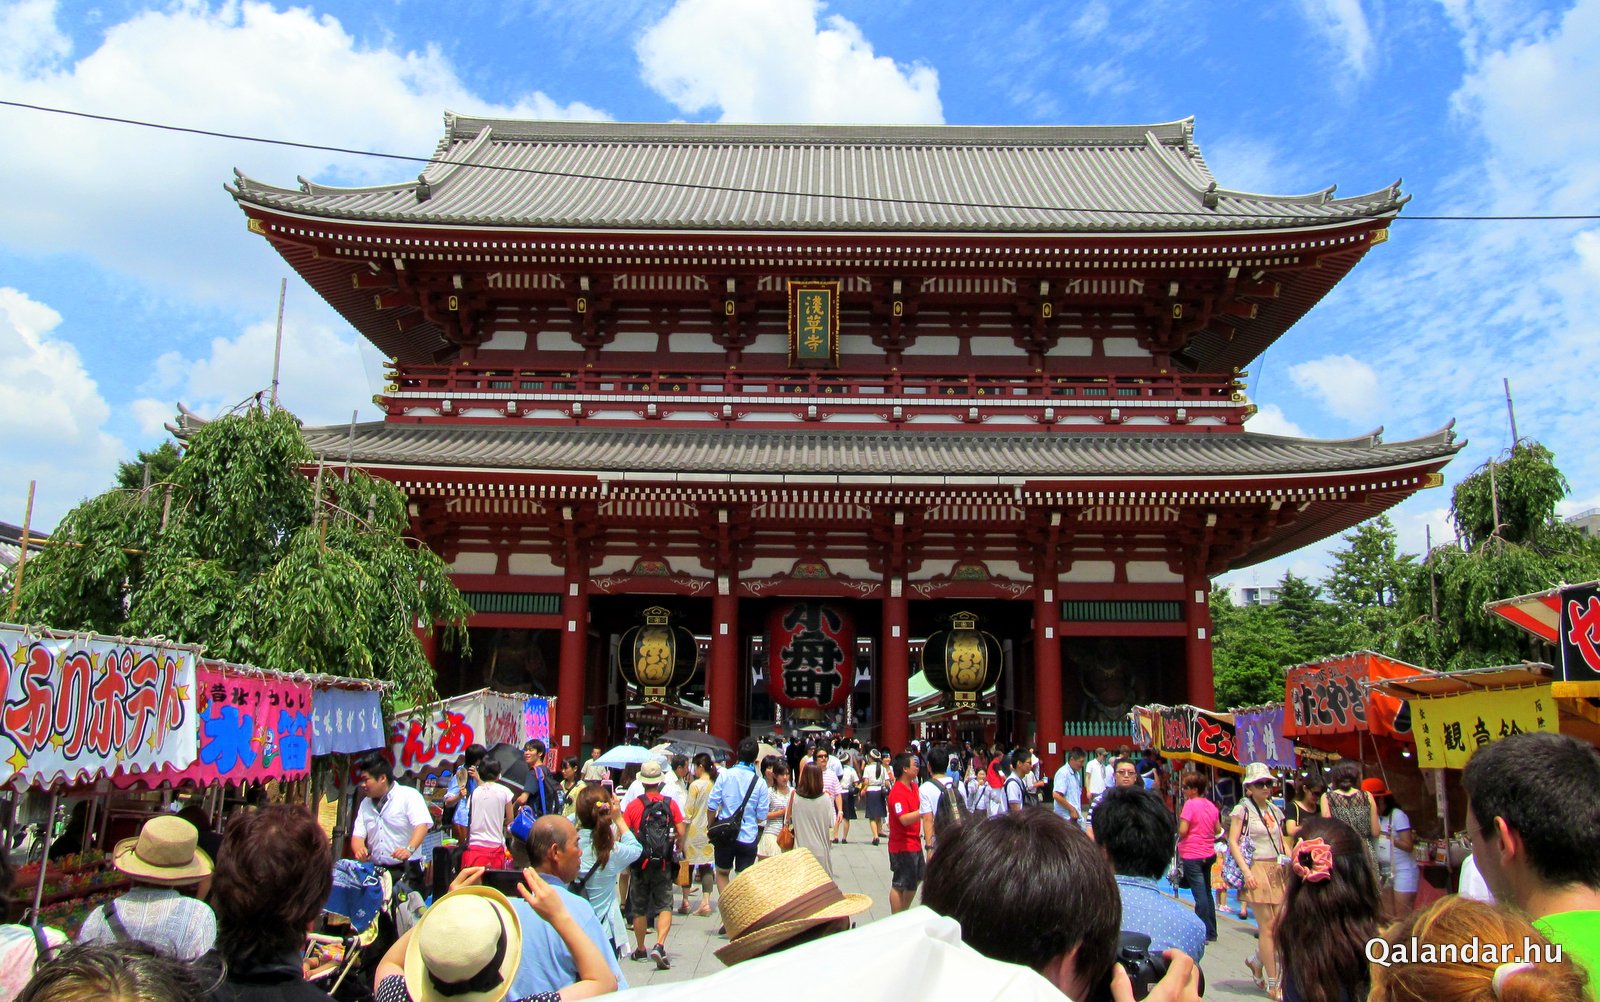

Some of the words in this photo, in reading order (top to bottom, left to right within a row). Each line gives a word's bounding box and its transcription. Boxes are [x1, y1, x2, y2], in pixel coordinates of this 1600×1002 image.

[780, 602, 844, 706] 小舟町
[1300, 674, 1369, 728] たこやき
